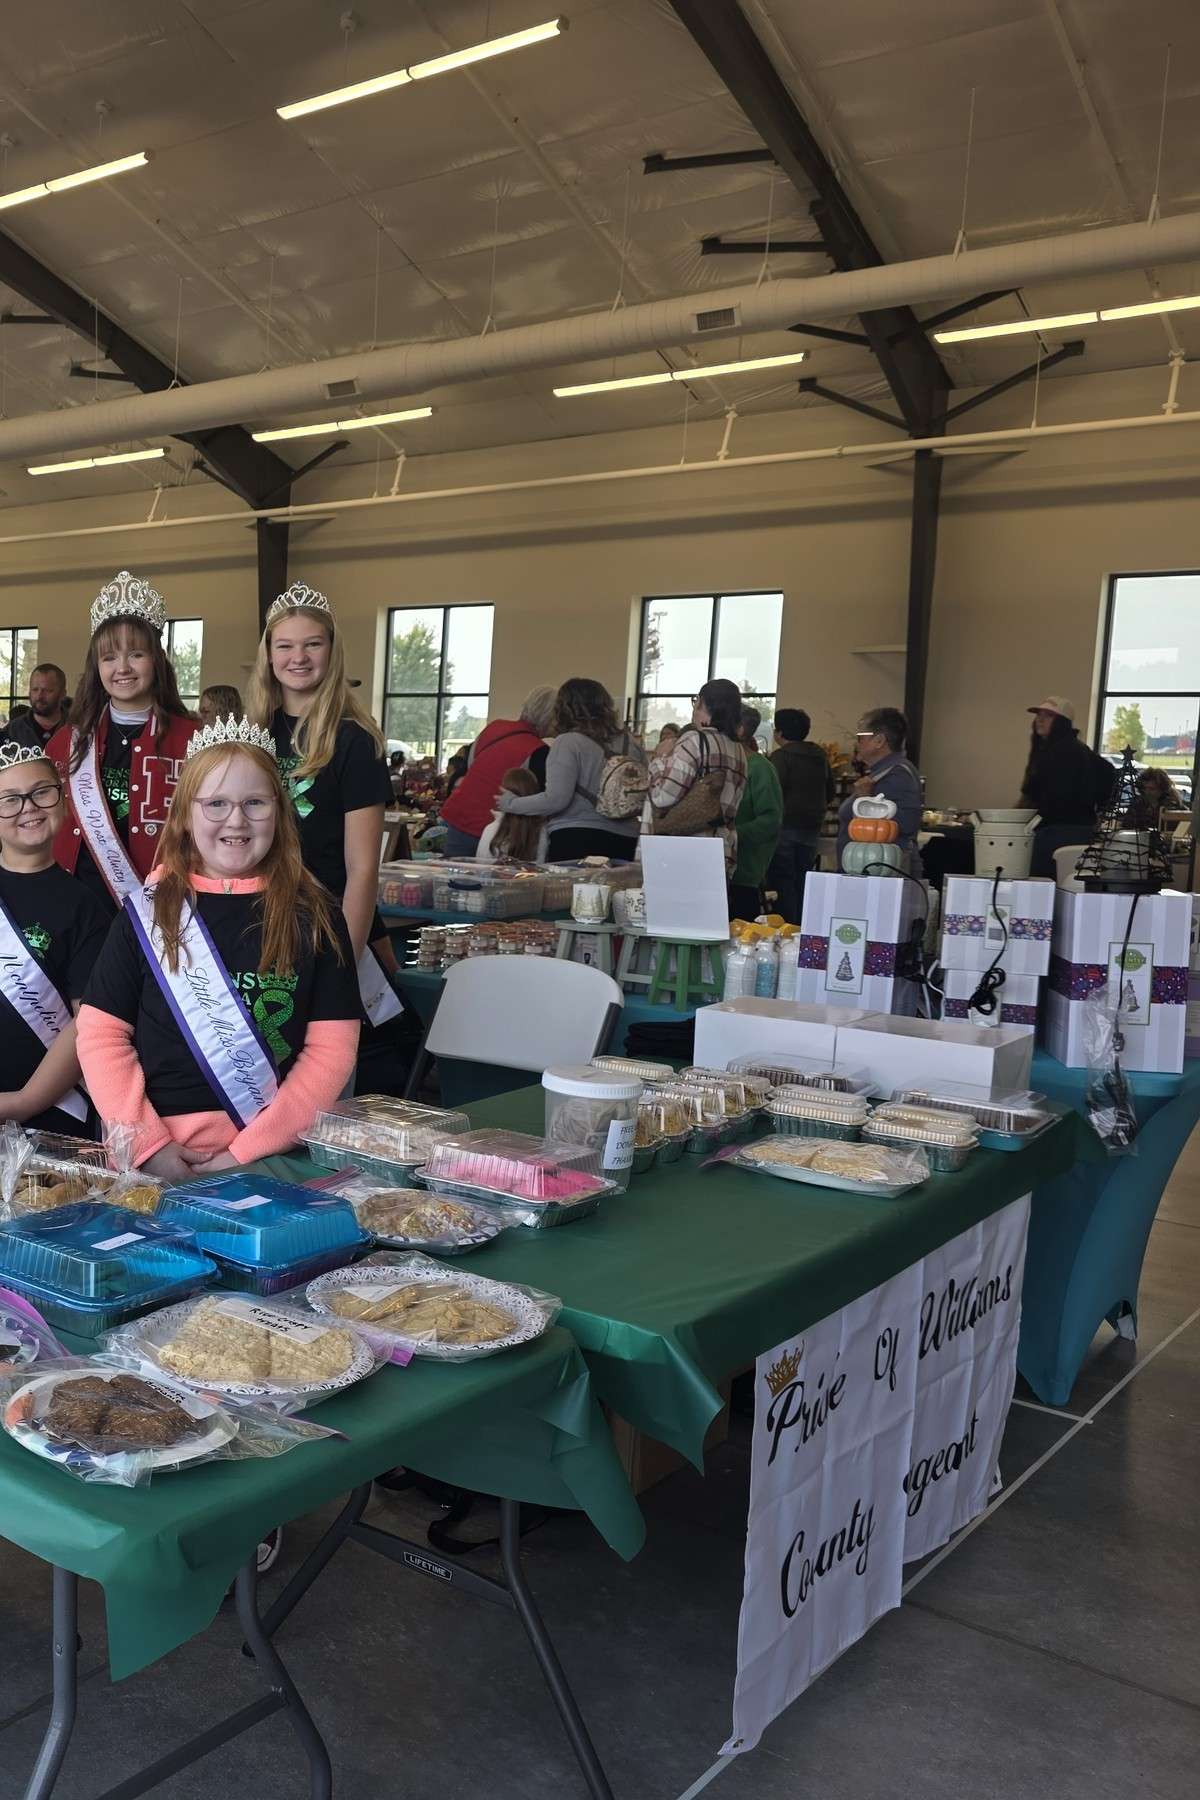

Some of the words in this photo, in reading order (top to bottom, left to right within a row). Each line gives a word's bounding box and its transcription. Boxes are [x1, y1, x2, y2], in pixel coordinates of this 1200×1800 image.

[76, 772, 93, 807] Miss
[106, 848, 125, 884] Unity
[182, 965, 221, 1011] Little
[206, 1010, 238, 1048] Miss
[226, 1048, 269, 1107] Bryan
[873, 1327, 900, 1392] Of
[917, 1265, 1013, 1360] Williams
[409, 1555, 446, 1577] LIFETIME
[781, 1498, 876, 1618] County
